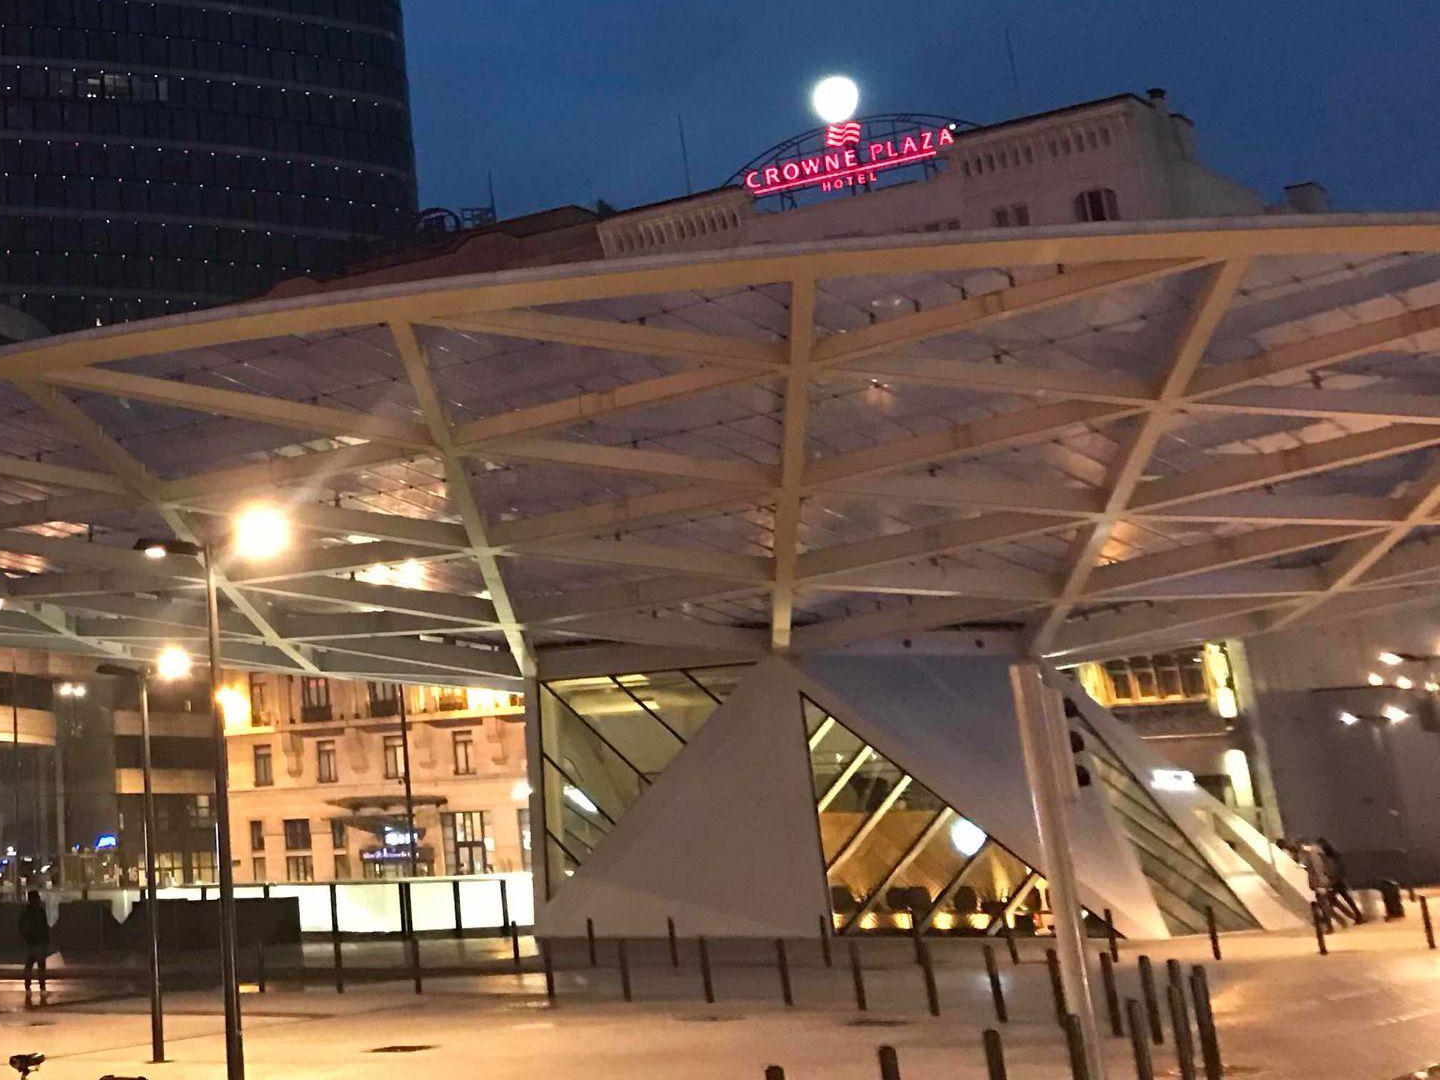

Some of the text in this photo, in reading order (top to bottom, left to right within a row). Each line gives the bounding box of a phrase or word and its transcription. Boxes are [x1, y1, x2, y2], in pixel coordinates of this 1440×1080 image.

[746, 127, 954, 188] CROWNE PLAZA
[822, 172, 877, 192] HOTEL
